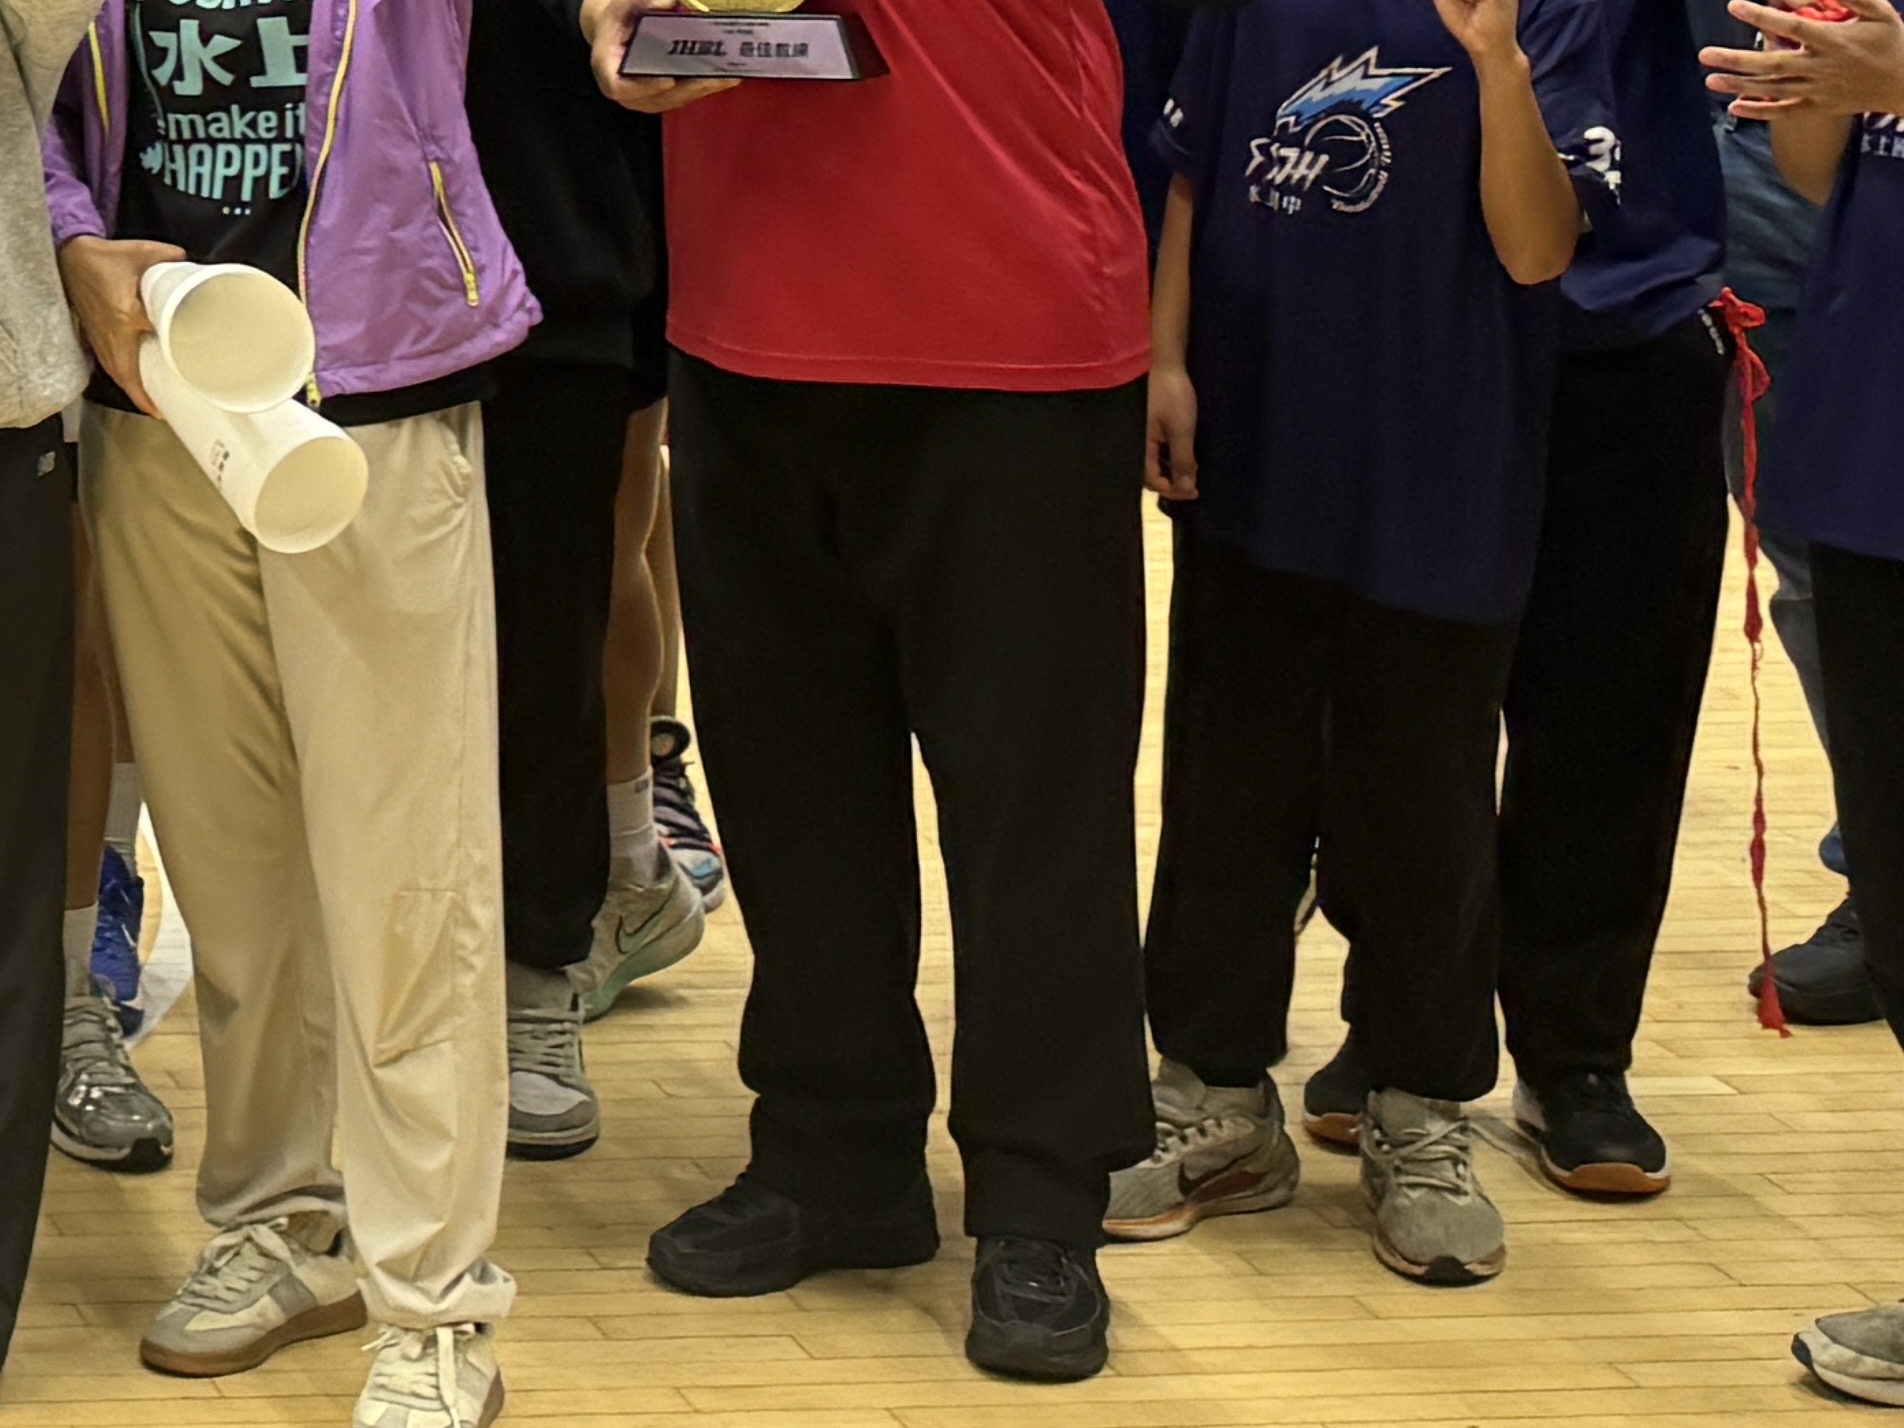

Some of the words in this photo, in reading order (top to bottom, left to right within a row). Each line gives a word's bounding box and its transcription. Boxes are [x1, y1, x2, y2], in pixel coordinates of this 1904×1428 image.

[147, 16, 309, 97] 水上
[167, 104, 279, 140] make
[285, 105, 307, 138] it
